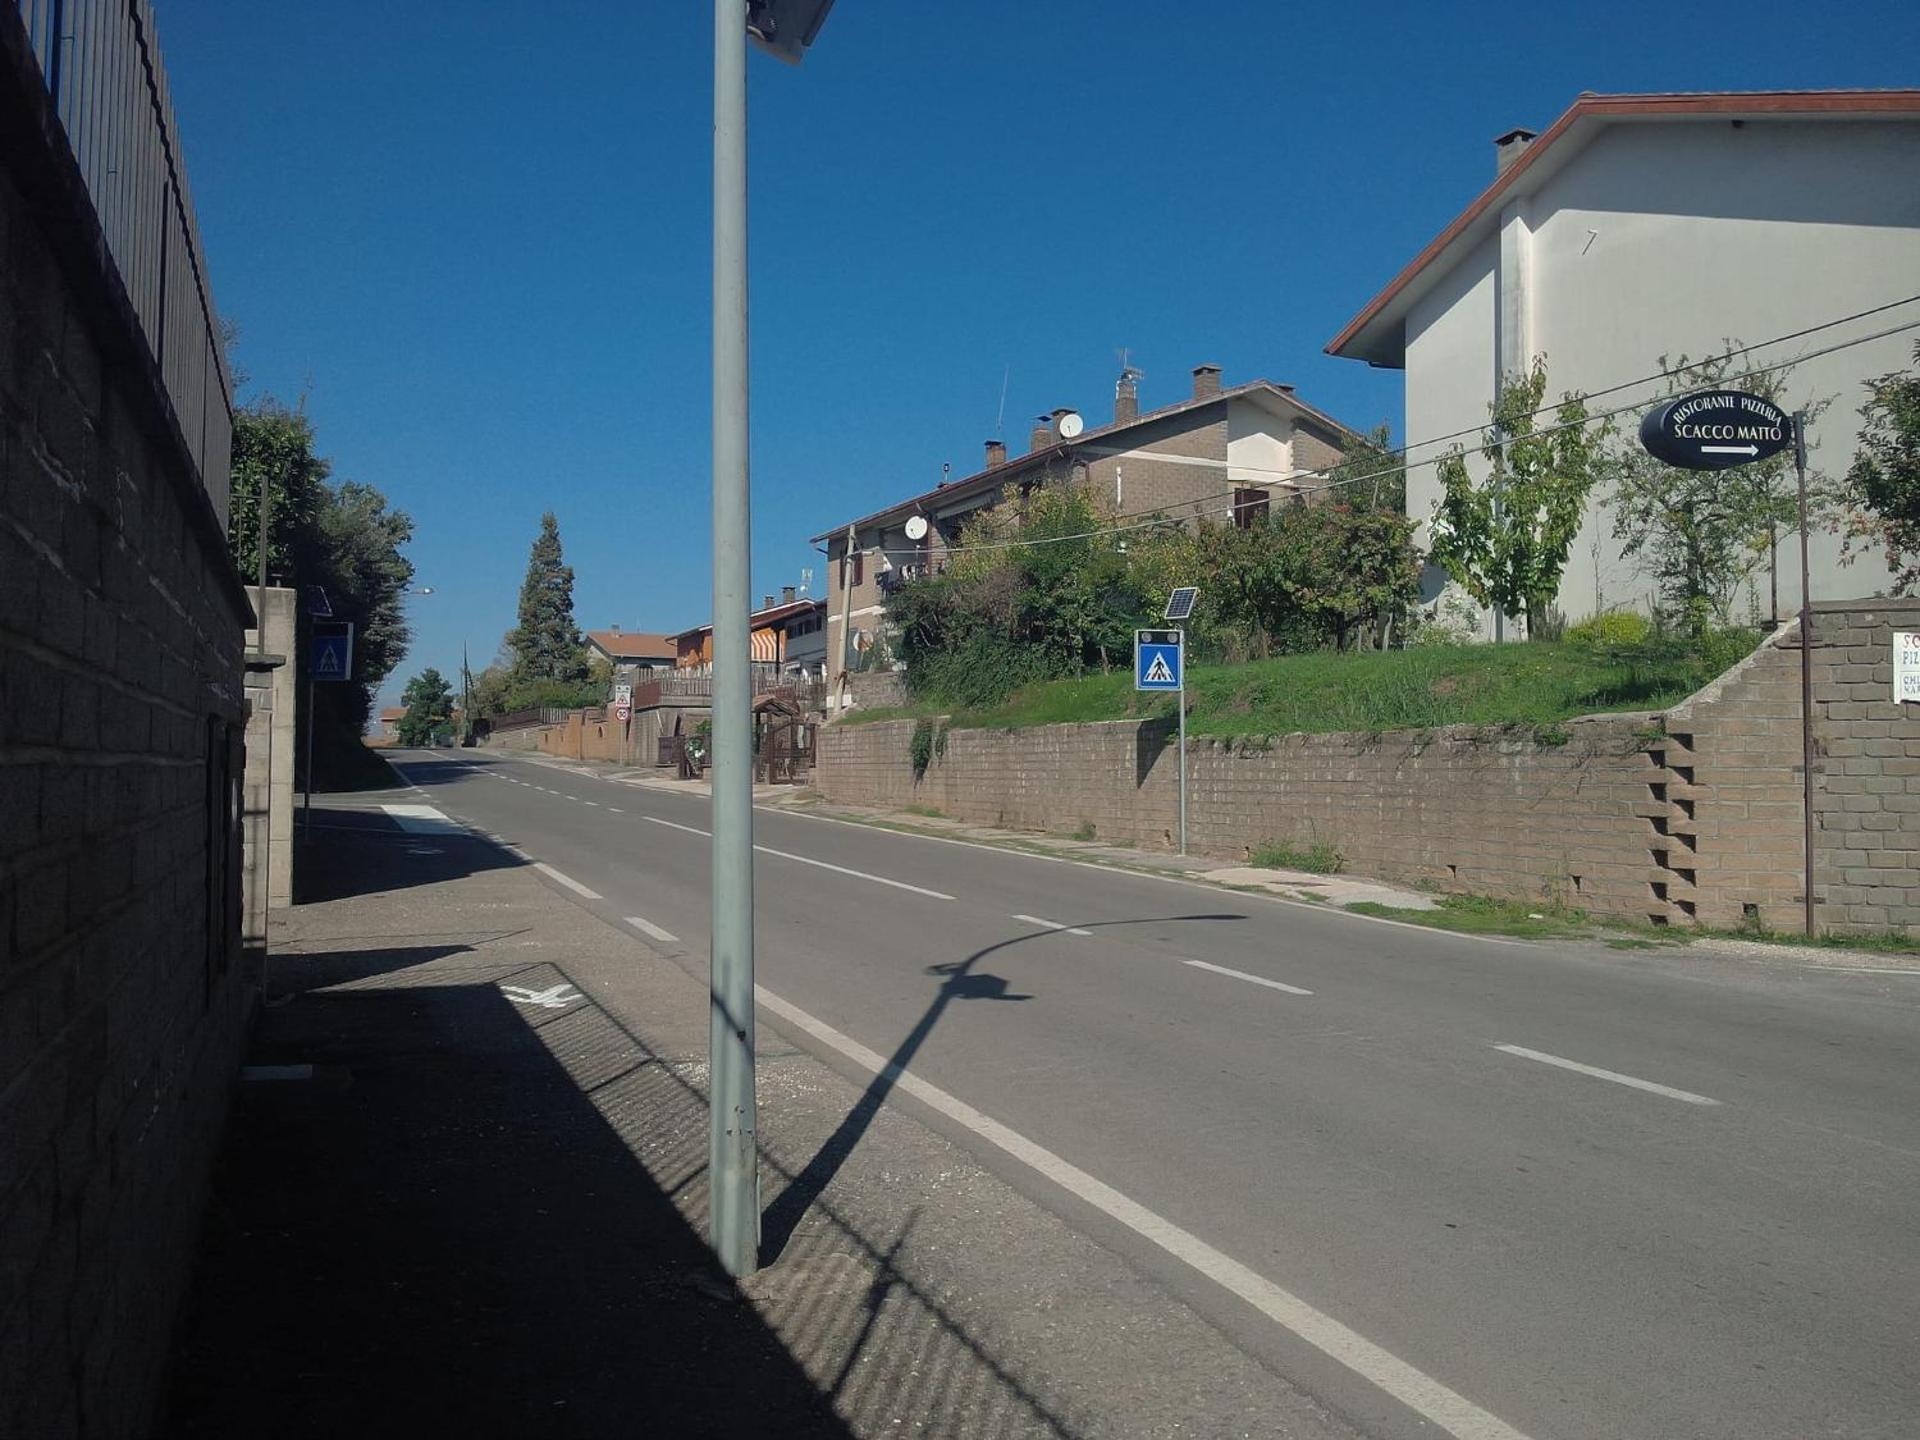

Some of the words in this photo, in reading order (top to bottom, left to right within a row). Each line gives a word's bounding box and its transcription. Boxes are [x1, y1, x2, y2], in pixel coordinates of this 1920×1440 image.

[1673, 396, 1735, 425] RISTORANTE
[1741, 397, 1783, 427] PIZZERIA
[1674, 425, 1734, 439] SCACCO
[1737, 426, 1782, 441] MATTO
